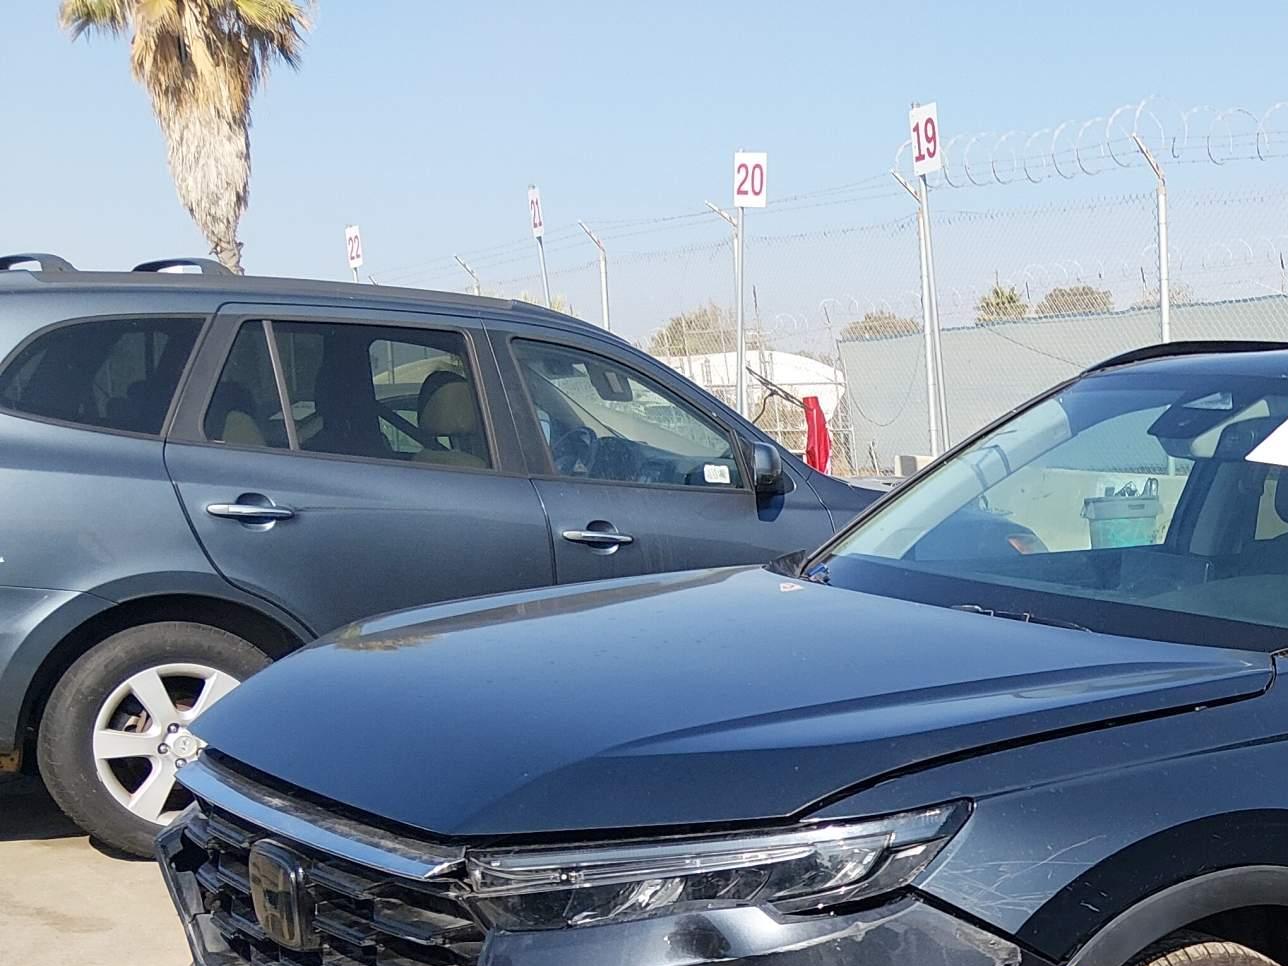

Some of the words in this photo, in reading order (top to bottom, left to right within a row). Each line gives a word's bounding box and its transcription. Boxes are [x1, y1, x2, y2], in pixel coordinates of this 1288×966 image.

[912, 116, 937, 163] 19
[736, 163, 764, 196] 20
[530, 197, 542, 229] 21
[348, 234, 361, 260] 22
